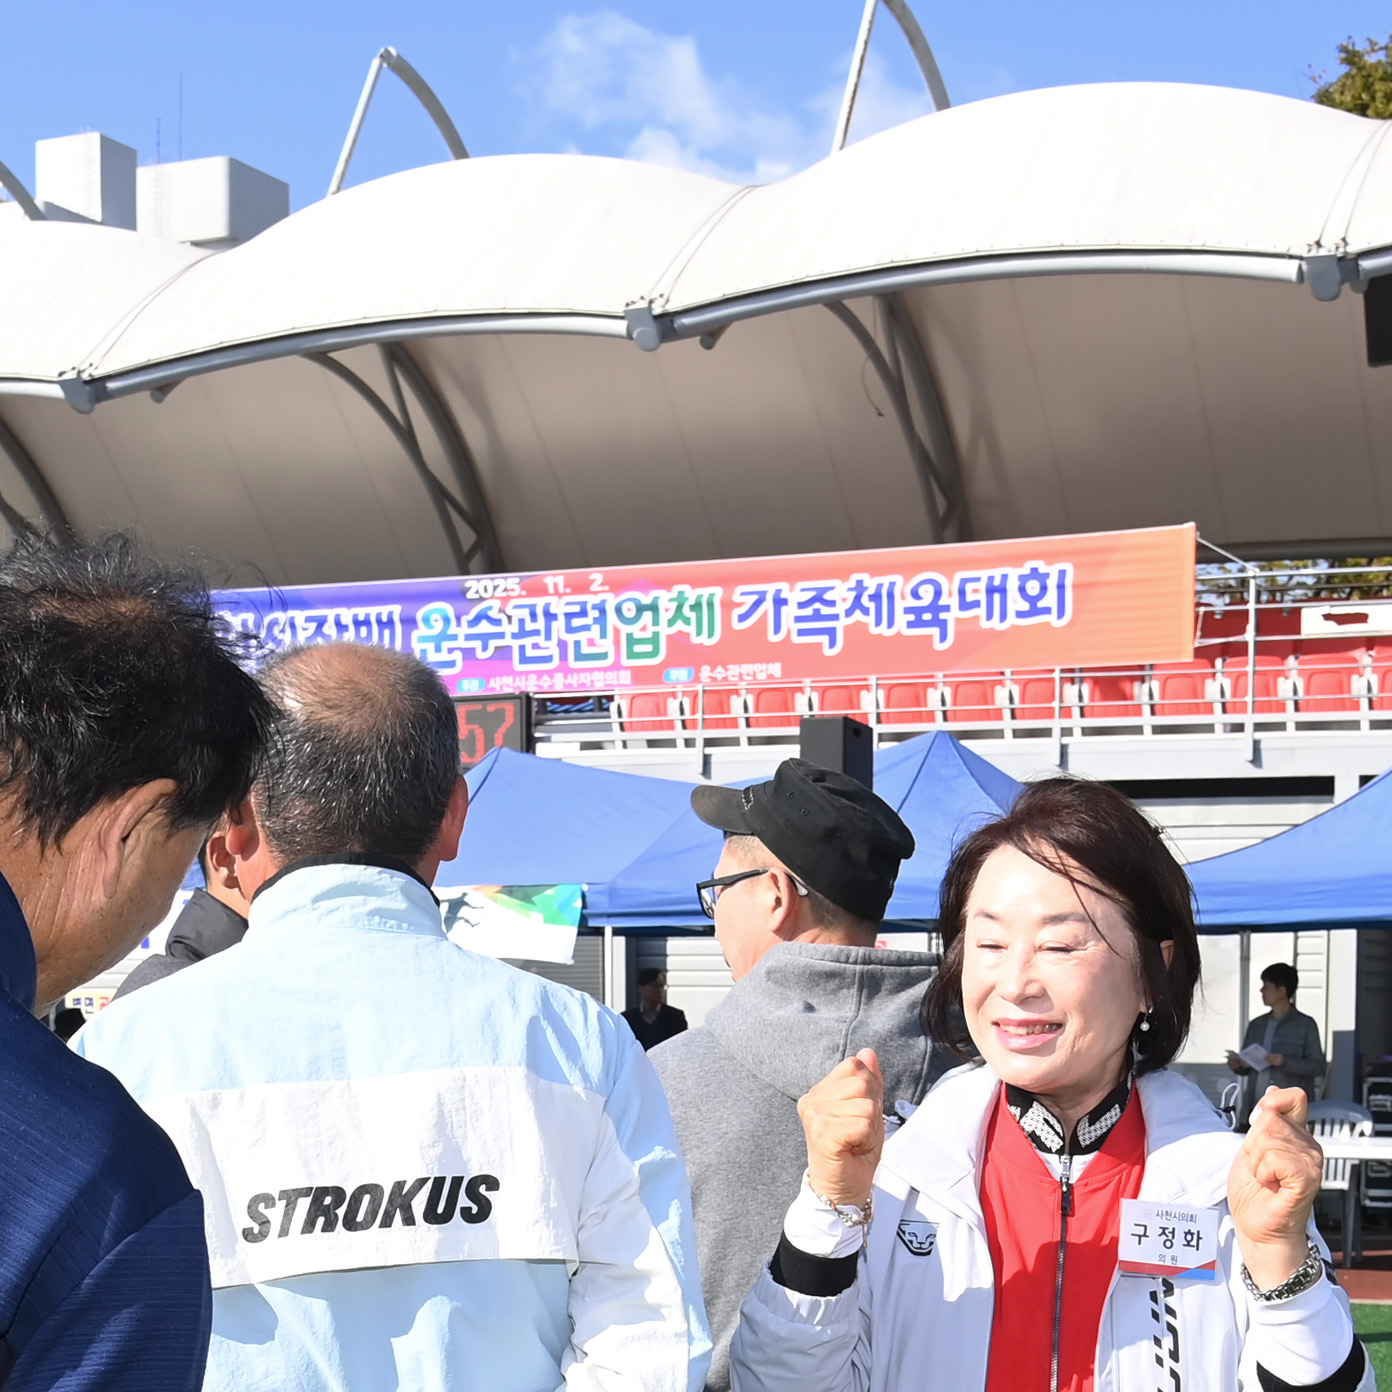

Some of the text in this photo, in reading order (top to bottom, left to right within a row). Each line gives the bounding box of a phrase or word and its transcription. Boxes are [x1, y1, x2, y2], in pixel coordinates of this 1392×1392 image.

[464, 573, 610, 600] 2025. 11. 2.
[414, 587, 720, 671] 운수관련업체
[734, 564, 1069, 652] 가족체육대회
[699, 662, 782, 682] 운수관련업체
[458, 702, 515, 764] 57
[242, 1174, 500, 1243] STROKUS
[1155, 1209, 1198, 1224] 사천시의회
[1131, 1223, 1203, 1251] 구정화
[1158, 1253, 1179, 1265] 의원
